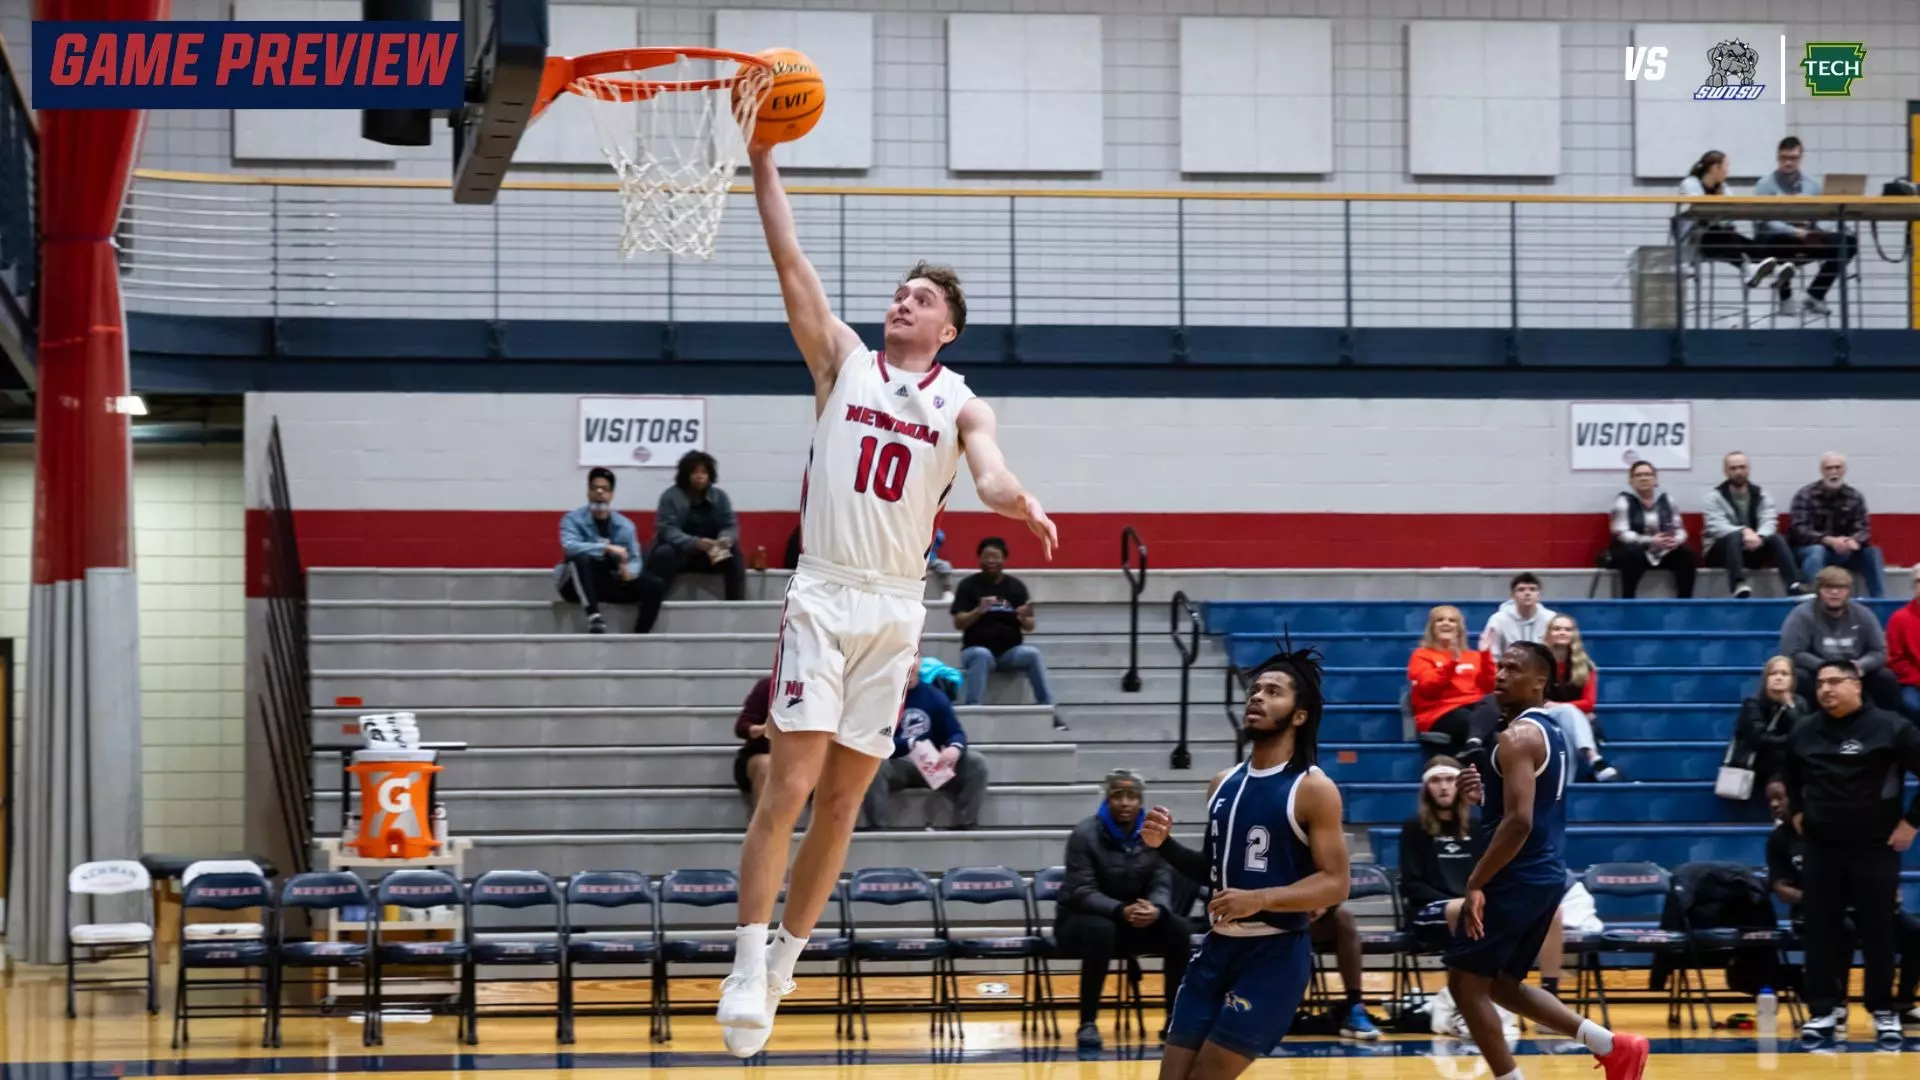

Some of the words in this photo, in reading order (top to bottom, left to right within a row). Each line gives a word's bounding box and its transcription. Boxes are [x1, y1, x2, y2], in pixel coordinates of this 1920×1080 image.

[585, 417, 700, 443] VISITORS
[1576, 422, 1686, 446] VISITORS
[854, 436, 912, 502] 10
[377, 777, 412, 814] G
[1244, 825, 1271, 873] 2
